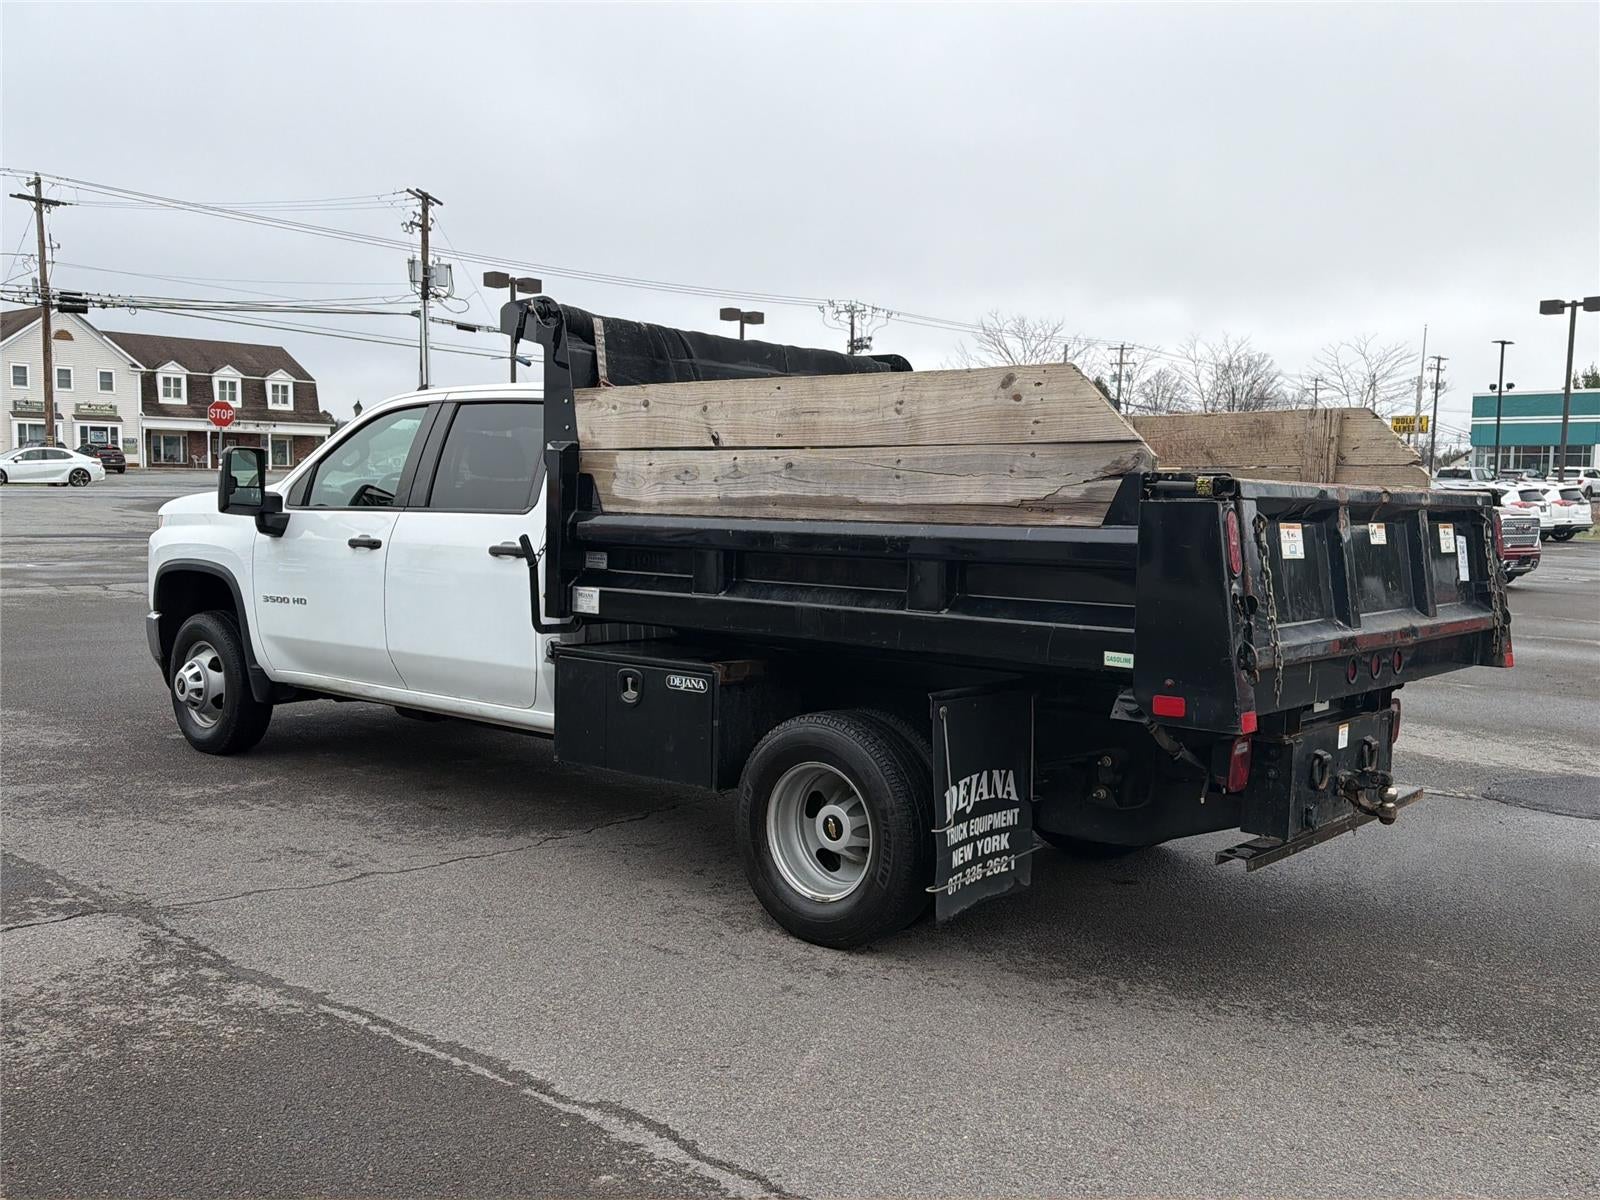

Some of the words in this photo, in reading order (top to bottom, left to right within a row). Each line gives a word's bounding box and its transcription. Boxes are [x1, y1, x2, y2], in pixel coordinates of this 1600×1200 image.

[210, 408, 234, 420] STOP
[262, 595, 290, 604] 3500
[292, 597, 307, 605] HD
[669, 676, 705, 690] DEJANA
[944, 769, 1019, 824] DEJANA
[946, 821, 969, 847] TRUCK
[969, 808, 1019, 837] EQUIPMENT
[952, 842, 974, 869] NEW
[976, 832, 1010, 857] YORK
